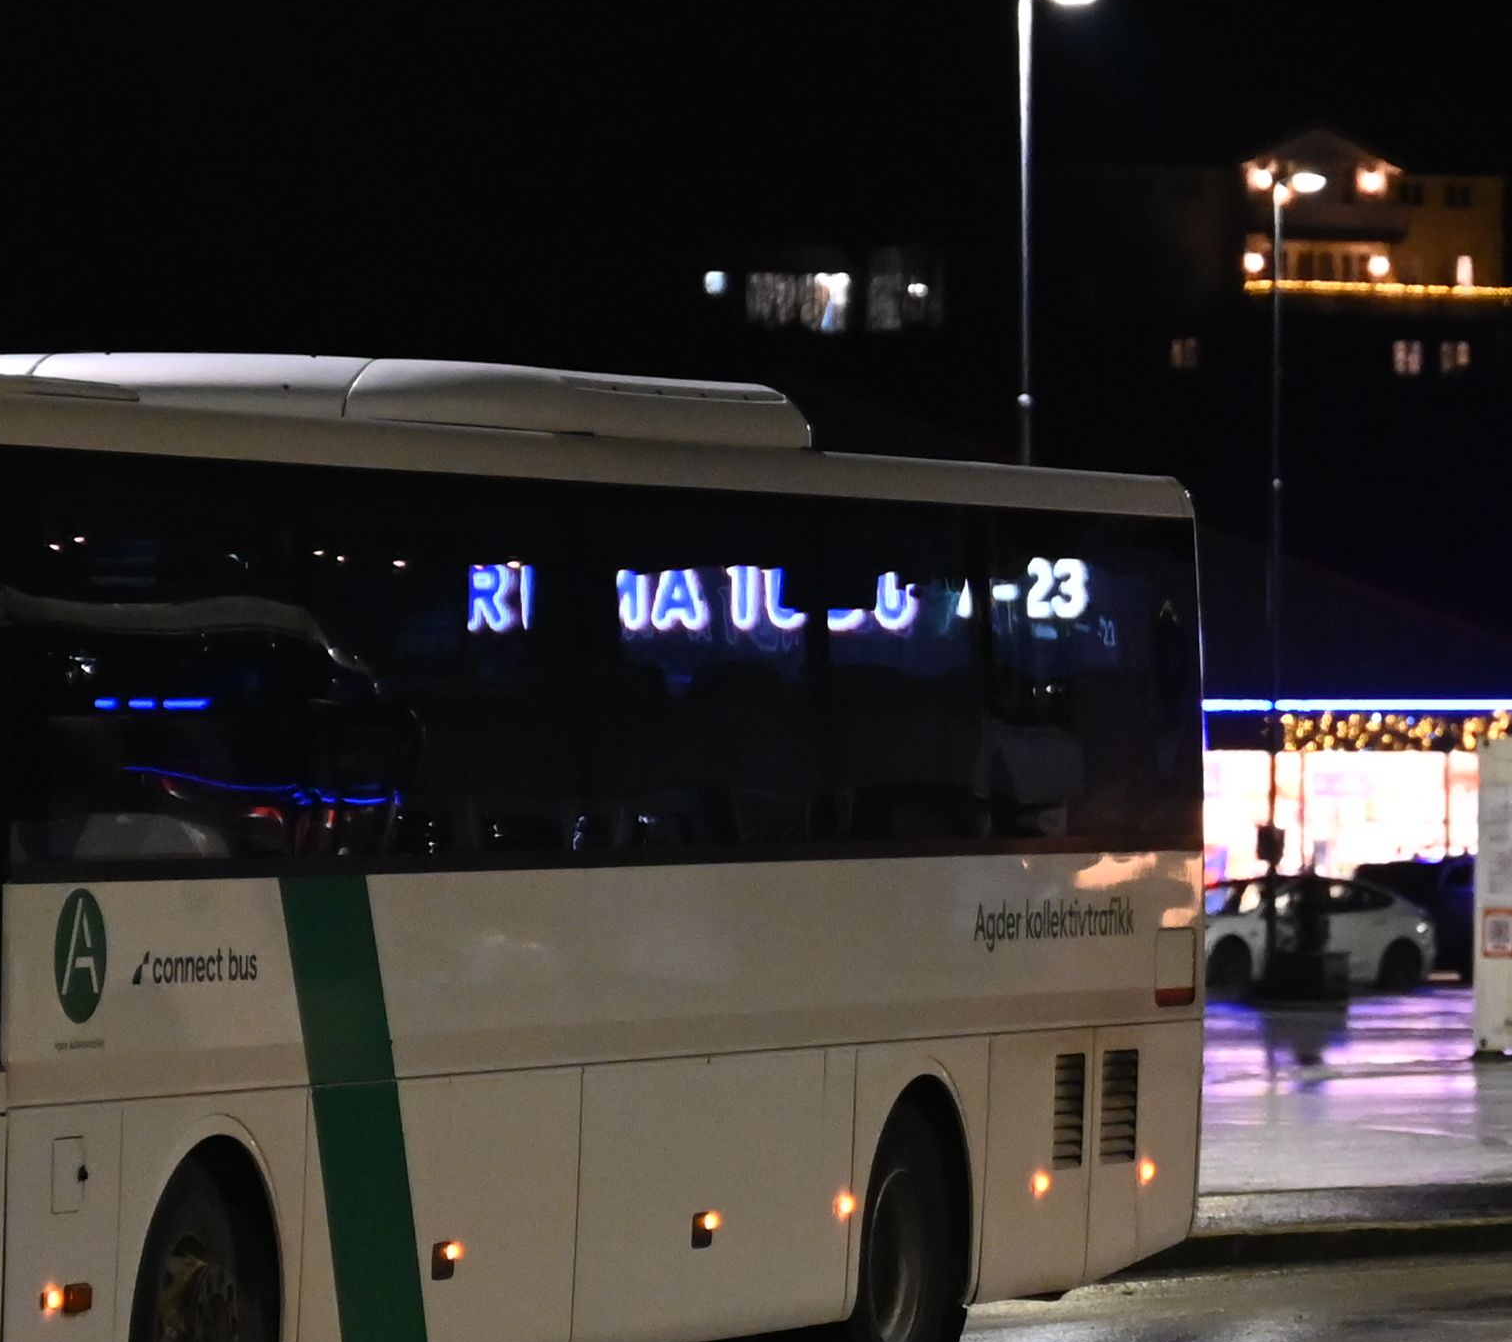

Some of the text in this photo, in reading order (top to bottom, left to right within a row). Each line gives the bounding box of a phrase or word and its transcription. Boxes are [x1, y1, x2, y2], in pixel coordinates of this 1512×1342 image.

[974, 896, 1134, 952] Agder kollektivtrafikk
[152, 947, 257, 984] connect bus
